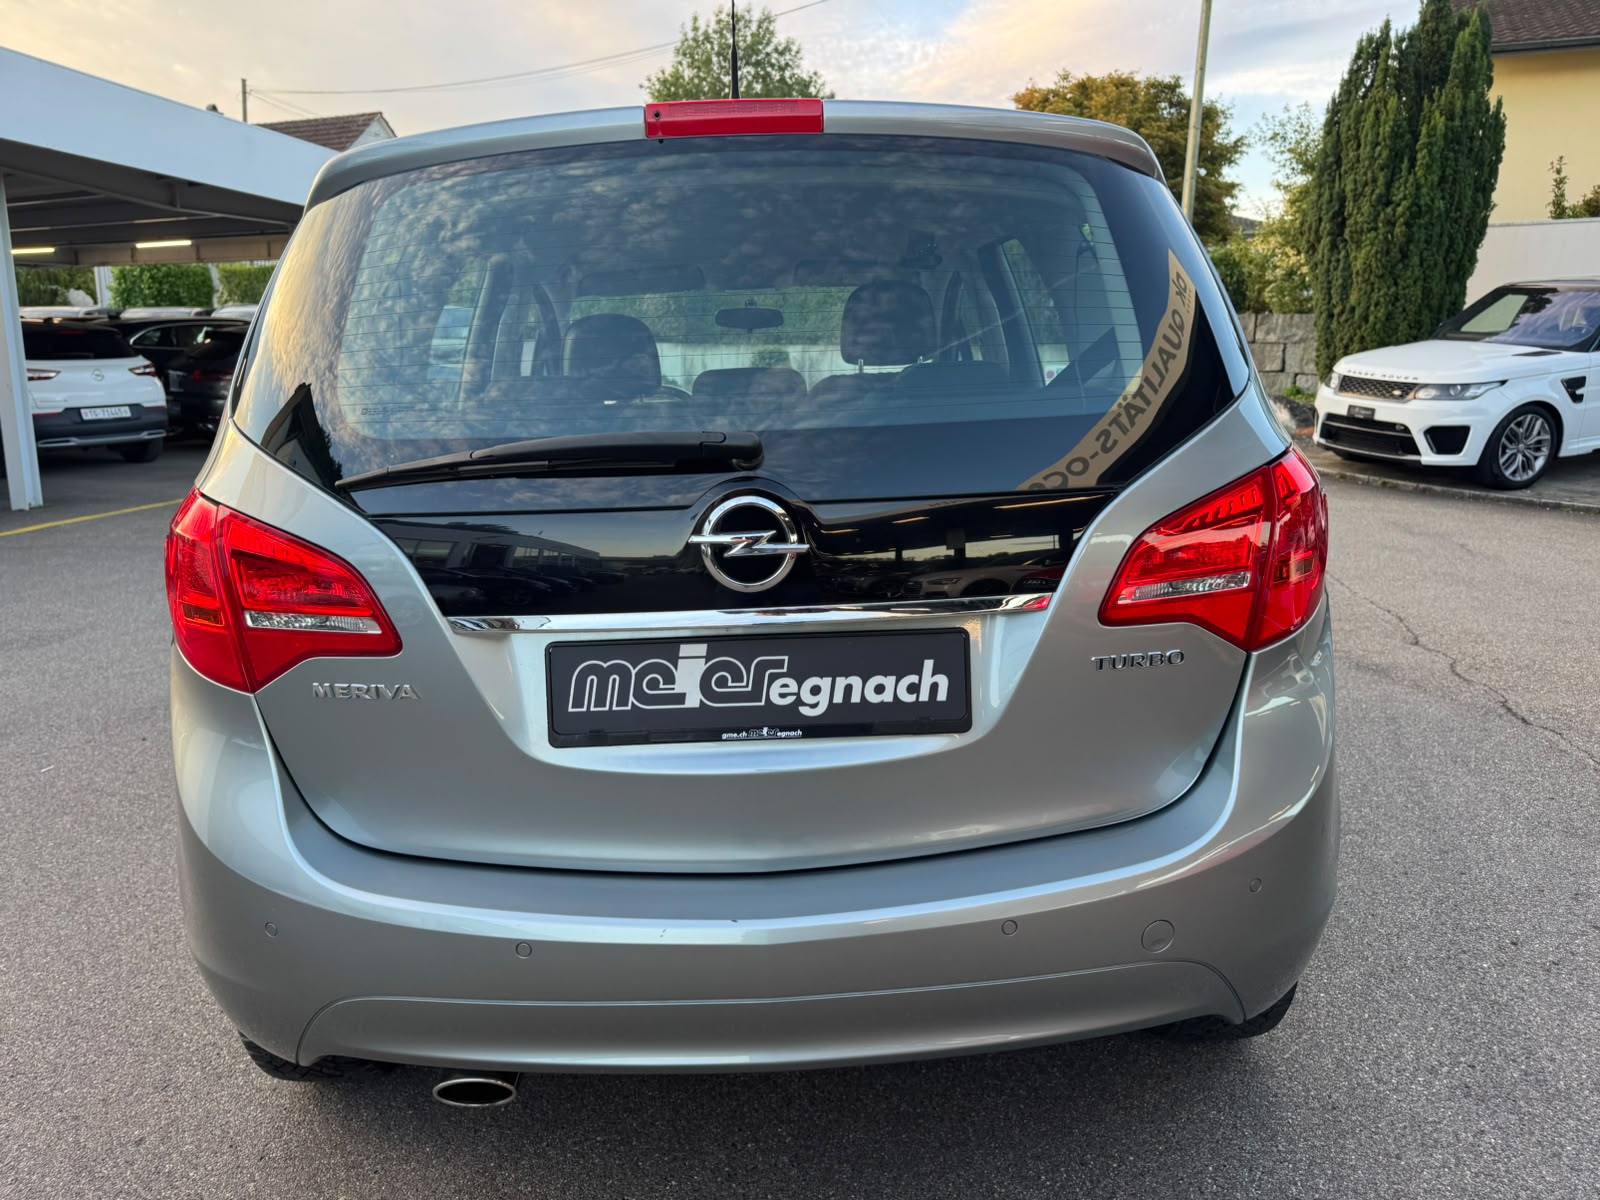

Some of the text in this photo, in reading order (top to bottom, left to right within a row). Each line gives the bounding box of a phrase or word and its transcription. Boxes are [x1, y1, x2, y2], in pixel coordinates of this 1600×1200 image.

[1090, 649, 1185, 671] TURBO
[568, 643, 949, 717] meier egnach
[312, 682, 420, 700] MERIVA
[721, 731, 748, 740] gme.ch
[777, 729, 803, 738] egnach
